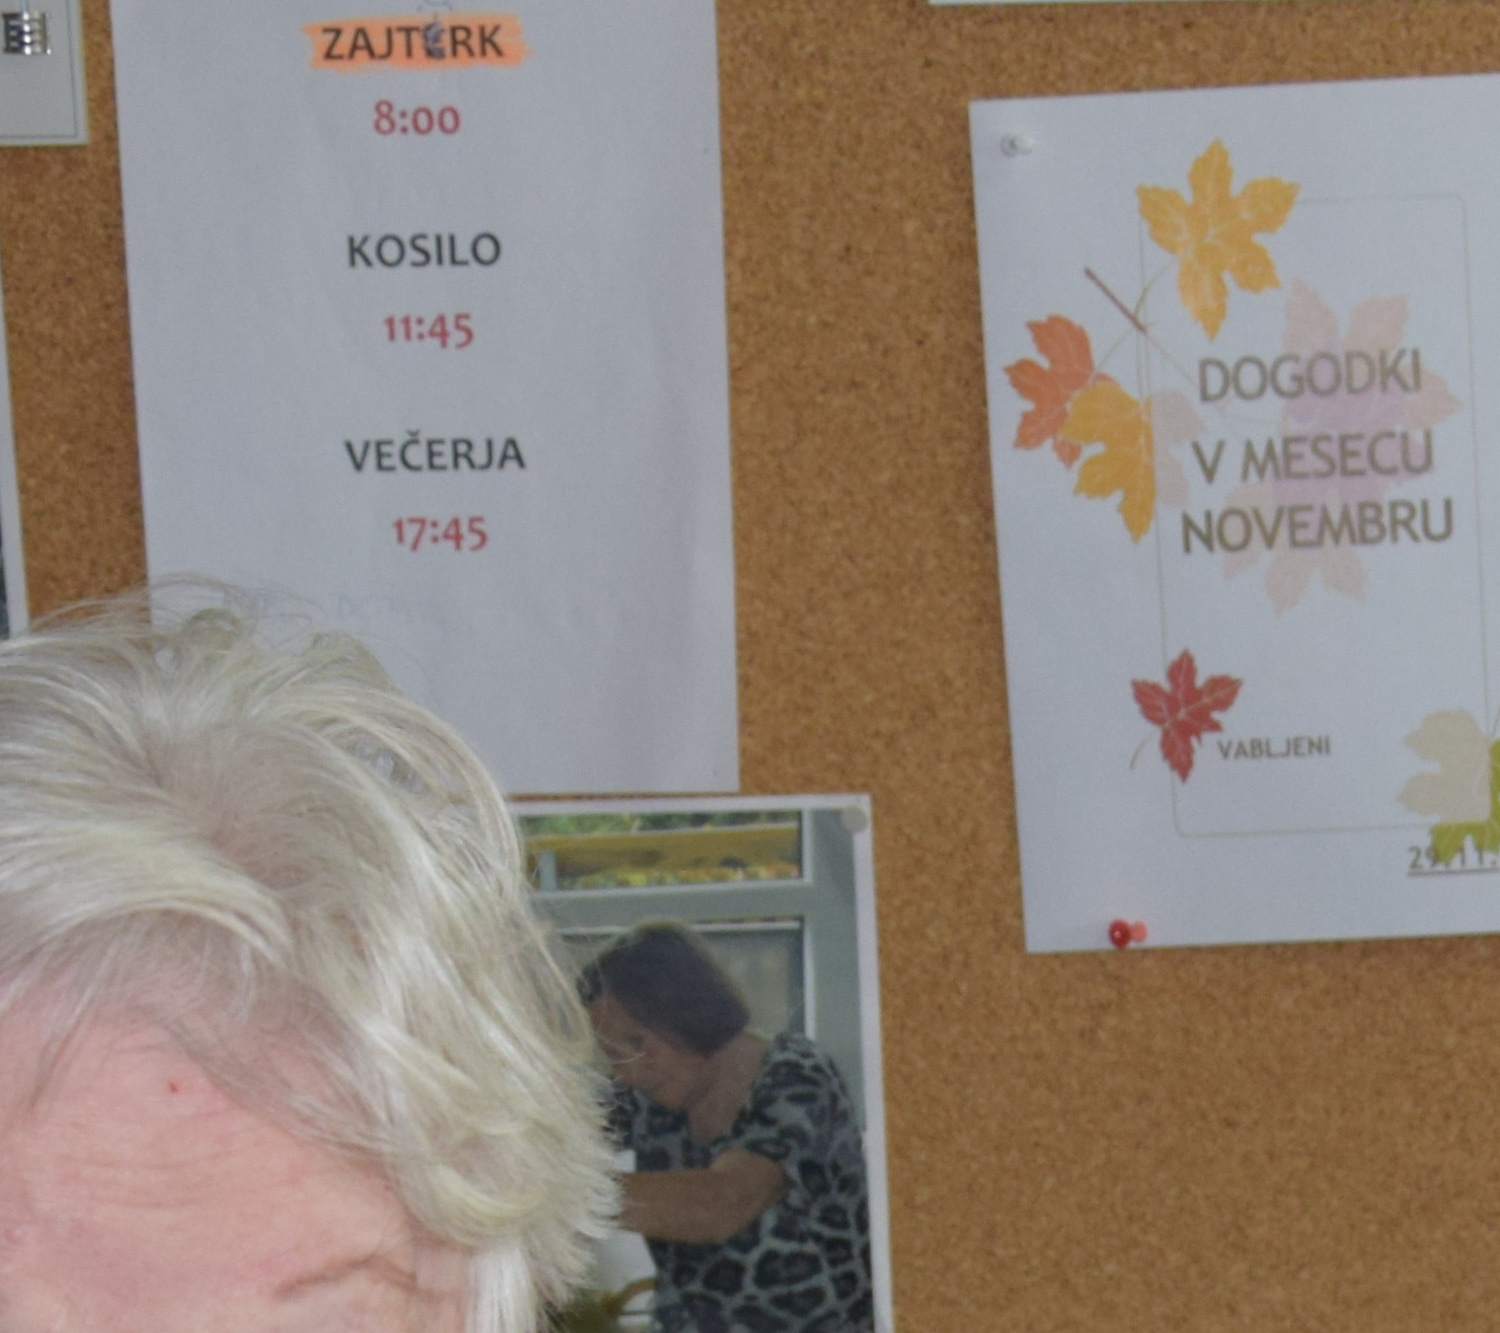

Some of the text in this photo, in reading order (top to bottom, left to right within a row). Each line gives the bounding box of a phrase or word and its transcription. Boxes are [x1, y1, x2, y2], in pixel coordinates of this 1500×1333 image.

[373, 99, 460, 135] 8:00
[346, 231, 503, 269] KOSILO
[383, 313, 475, 349] 11:45
[1198, 348, 1422, 404] DOGODKI
[345, 429, 526, 473] VEČERJA
[1192, 429, 1434, 484] V MESECU
[393, 516, 488, 553] 17:45
[1181, 498, 1453, 555] NOVEMBRU
[1217, 736, 1332, 760] VABLJENI
